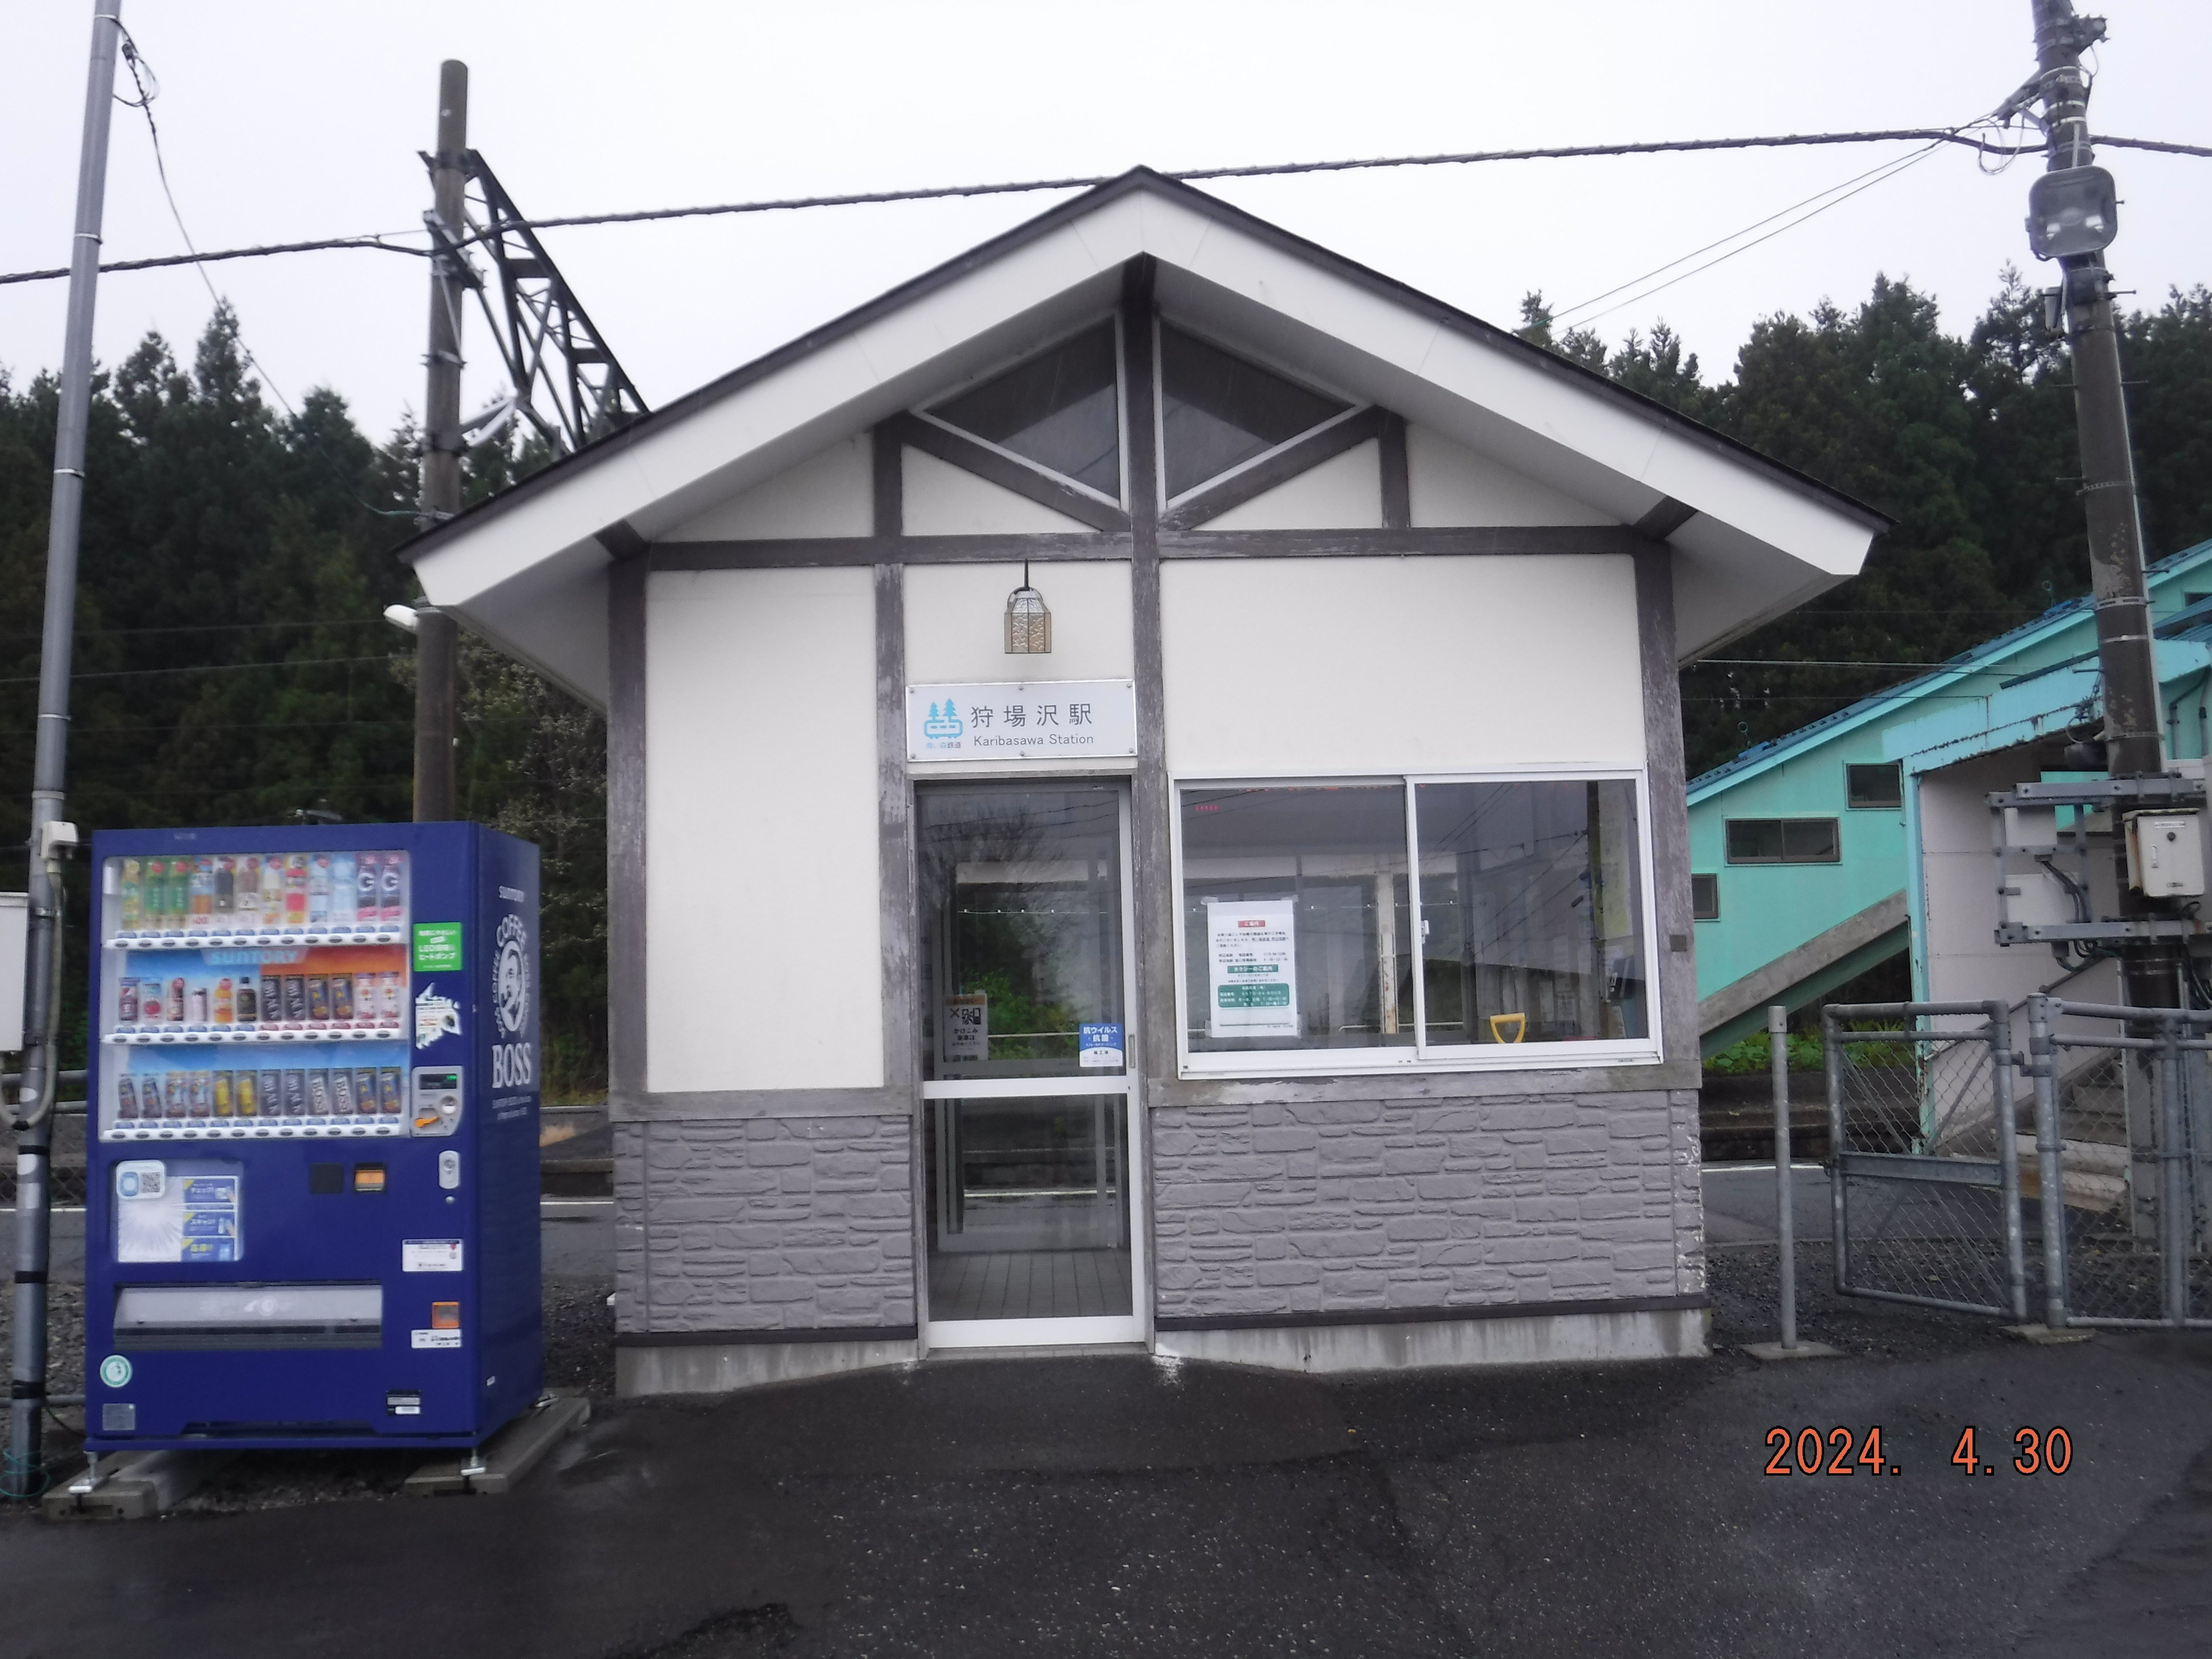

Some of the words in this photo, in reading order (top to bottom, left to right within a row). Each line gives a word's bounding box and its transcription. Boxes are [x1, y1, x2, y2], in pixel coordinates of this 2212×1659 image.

[971, 703, 1092, 728] 狩場沢駅
[974, 734, 1044, 746] Karibasawa
[1049, 733, 1094, 745] Station
[1083, 1026, 1118, 1034] 抗ウイルス
[492, 1042, 532, 1089] BOSS
